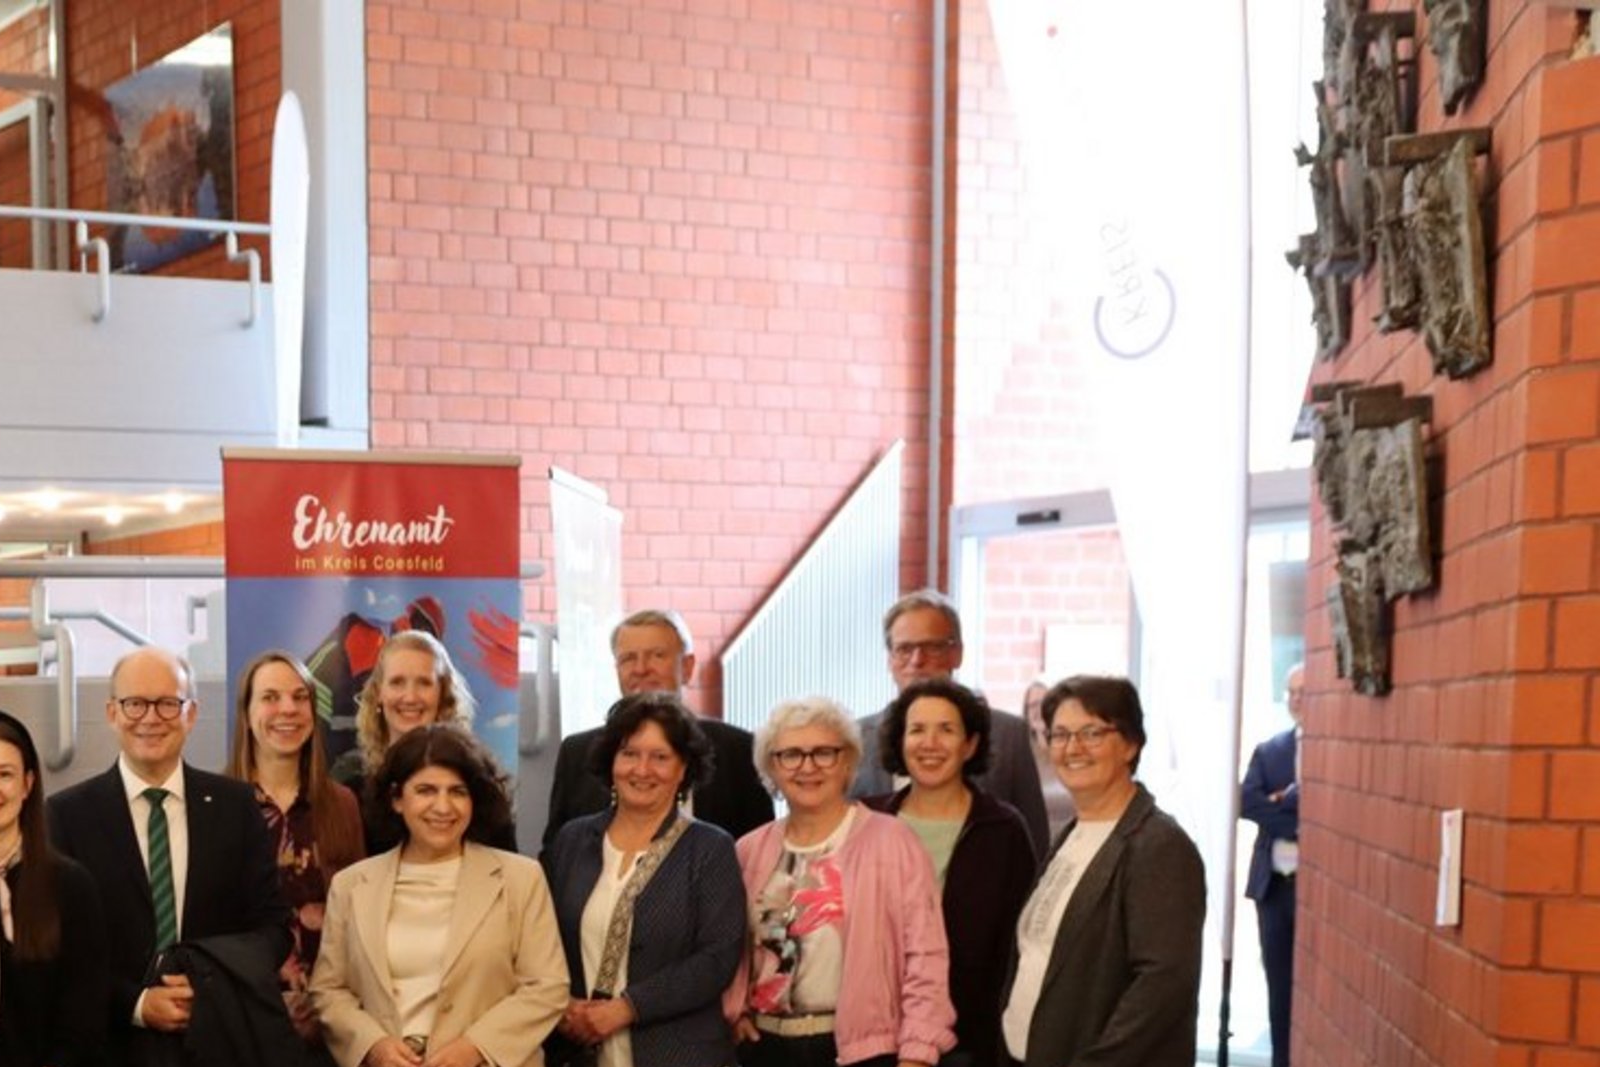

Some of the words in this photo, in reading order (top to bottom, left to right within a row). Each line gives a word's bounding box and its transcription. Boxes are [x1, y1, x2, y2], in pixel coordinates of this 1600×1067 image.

[292, 494, 454, 550] Ehrenamt
[295, 554, 316, 570] im
[323, 554, 367, 570] Kreis
[373, 554, 444, 571] Coesfeld
